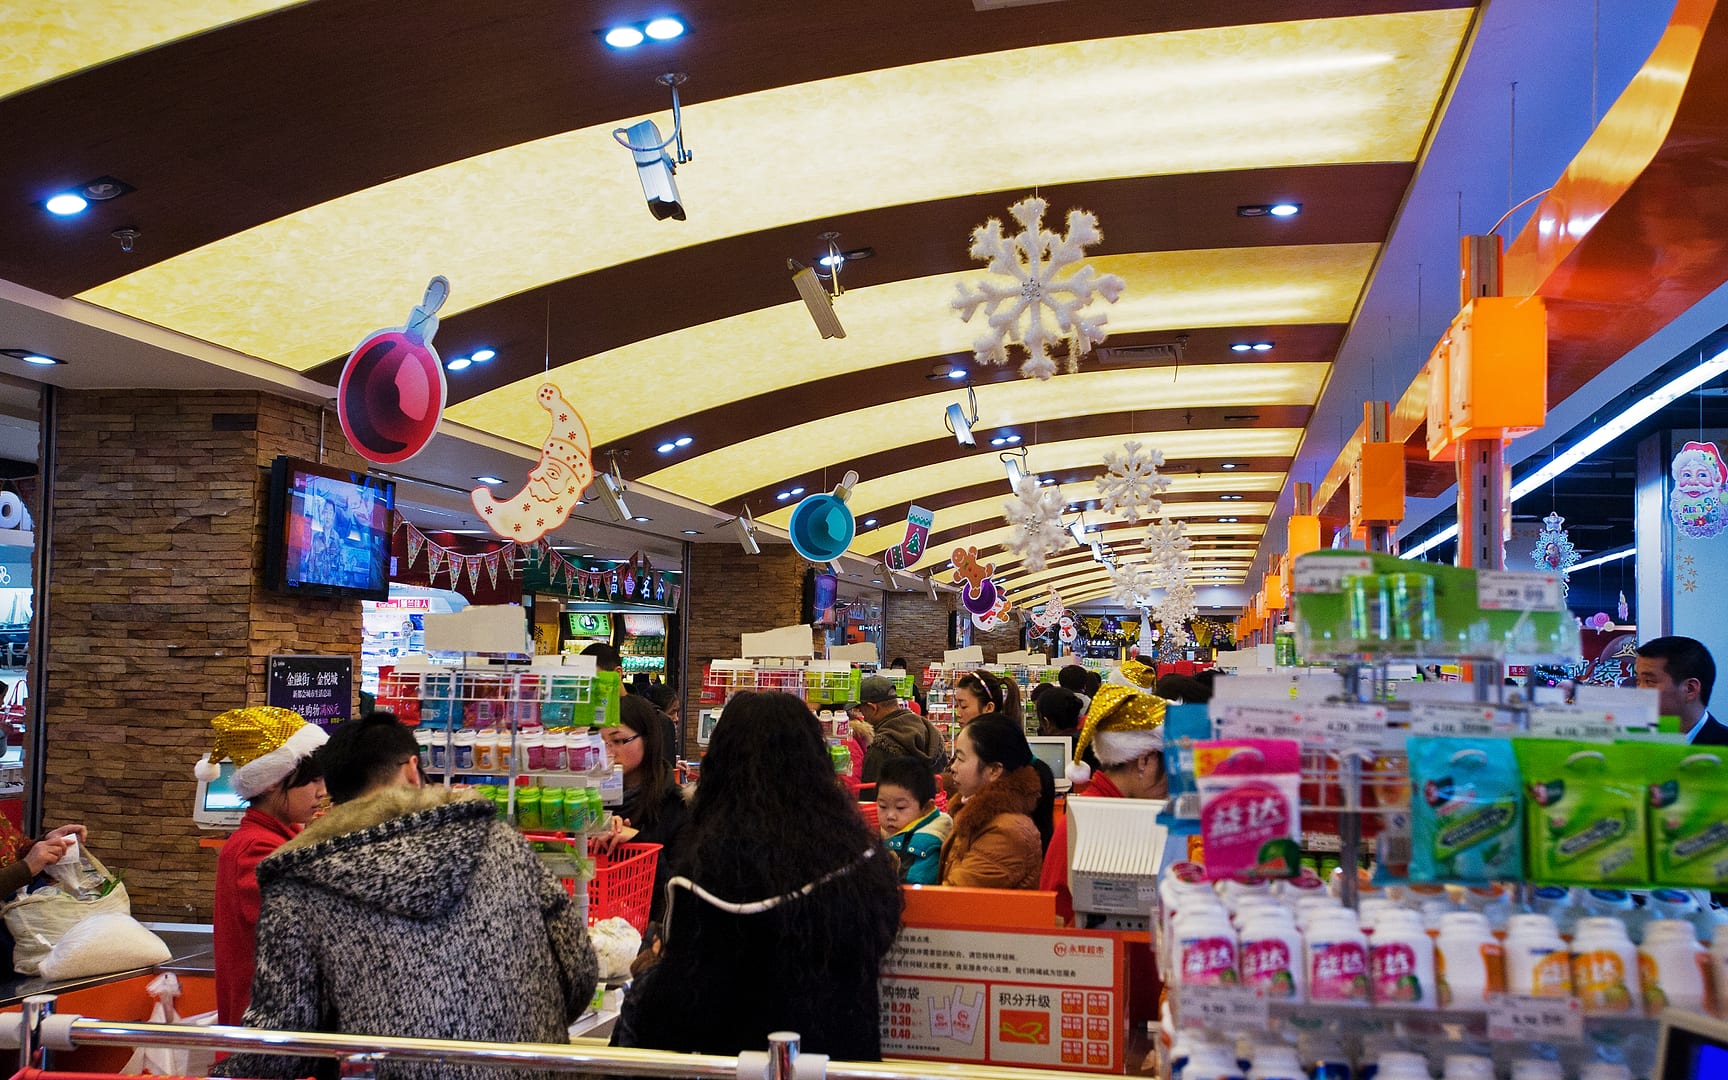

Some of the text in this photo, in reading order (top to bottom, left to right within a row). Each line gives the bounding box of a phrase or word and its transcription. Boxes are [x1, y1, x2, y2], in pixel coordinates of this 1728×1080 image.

[1210, 797, 1285, 839] 益达
[1185, 947, 1233, 974] 益达
[882, 985, 920, 1001] 购物袋
[999, 992, 1051, 1009] 积分升级
[891, 1002, 912, 1014] 0.20
[890, 1015, 912, 1028] 0.30
[890, 1027, 912, 1040] 0.40
